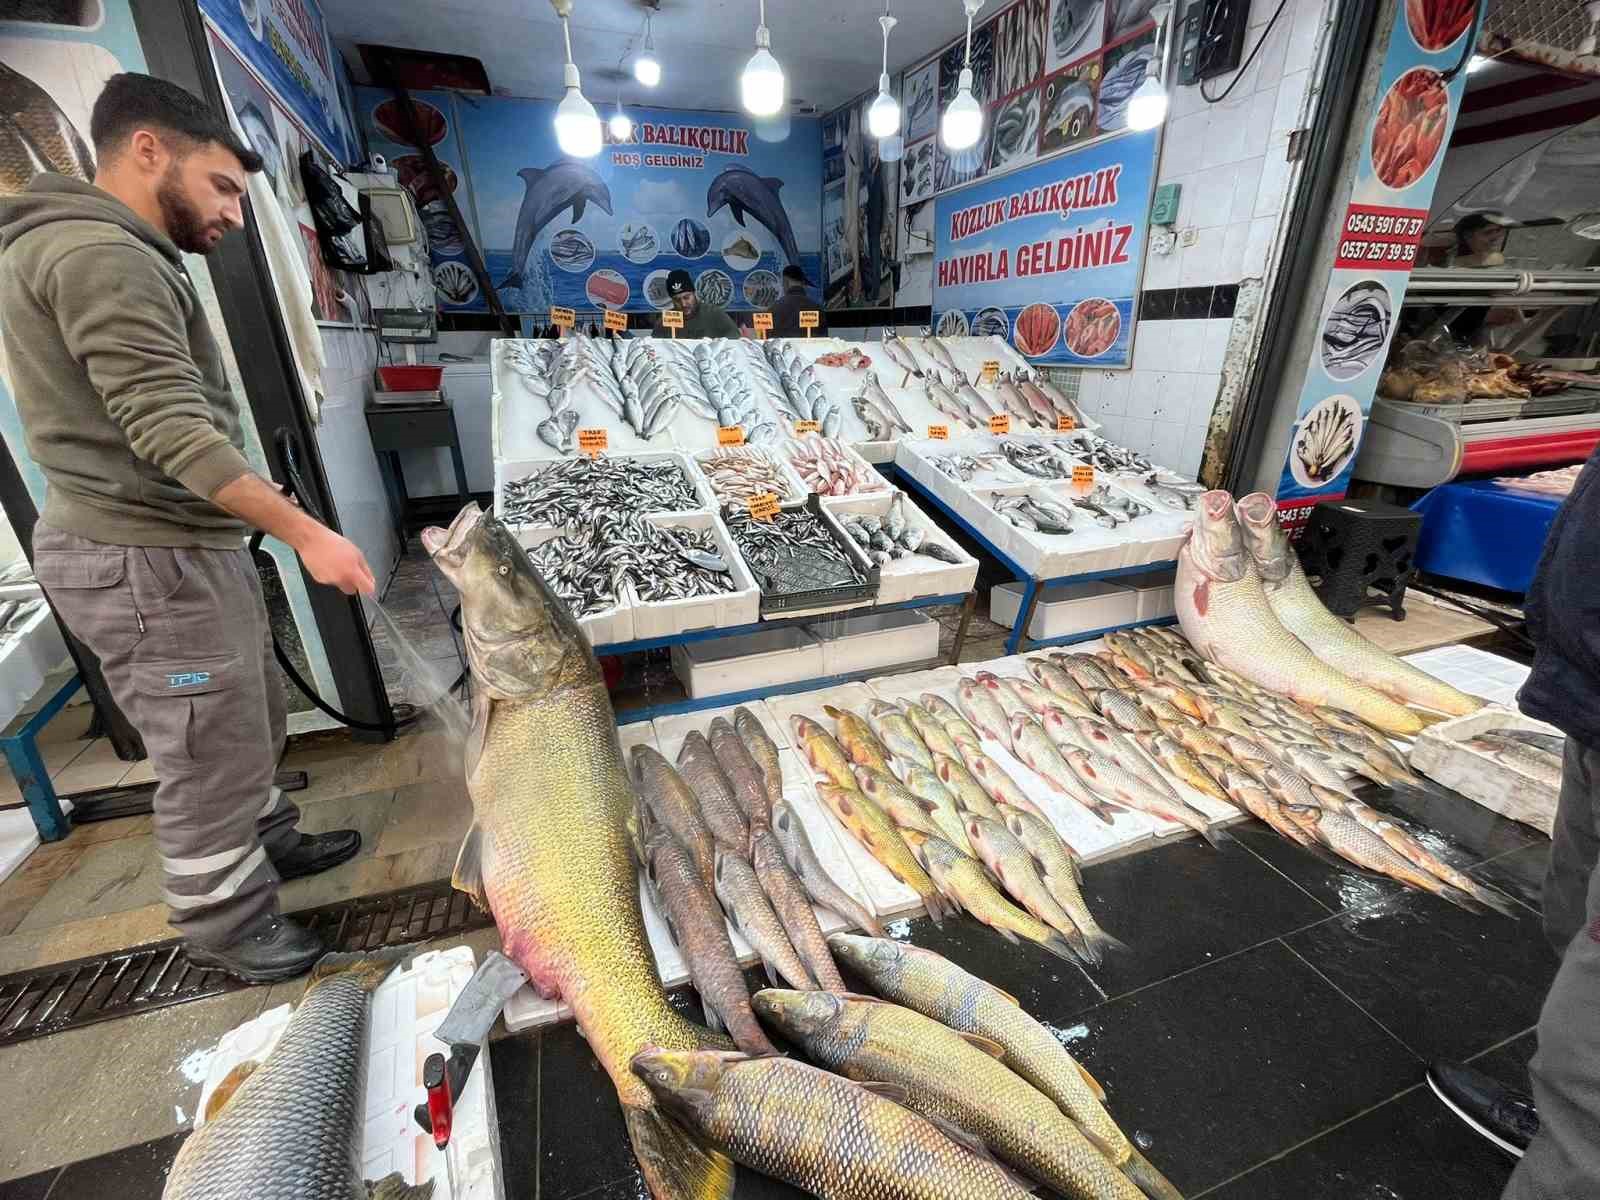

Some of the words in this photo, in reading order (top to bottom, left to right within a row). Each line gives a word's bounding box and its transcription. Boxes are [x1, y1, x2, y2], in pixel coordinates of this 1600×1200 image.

[642, 124, 749, 156] BALIKÇILIK
[612, 153, 641, 168] HOŞ
[644, 153, 704, 169] GELDİNİZ
[950, 199, 1008, 241] KOZLUK
[1008, 166, 1121, 219] BALIKÇILIK
[1347, 214, 1375, 232] 0543
[1375, 216, 1394, 234] 591
[1394, 218, 1408, 235] 67
[1408, 219, 1423, 236] 37
[938, 249, 1009, 287] HAYIRLA
[1015, 220, 1134, 278] GELDİNİZ
[1340, 241, 1367, 258] 0537
[1367, 242, 1387, 259] 257
[1387, 244, 1401, 260] 39
[1401, 244, 1416, 261] 35
[1277, 508, 1298, 522] 543
[1298, 506, 1315, 520] 59
